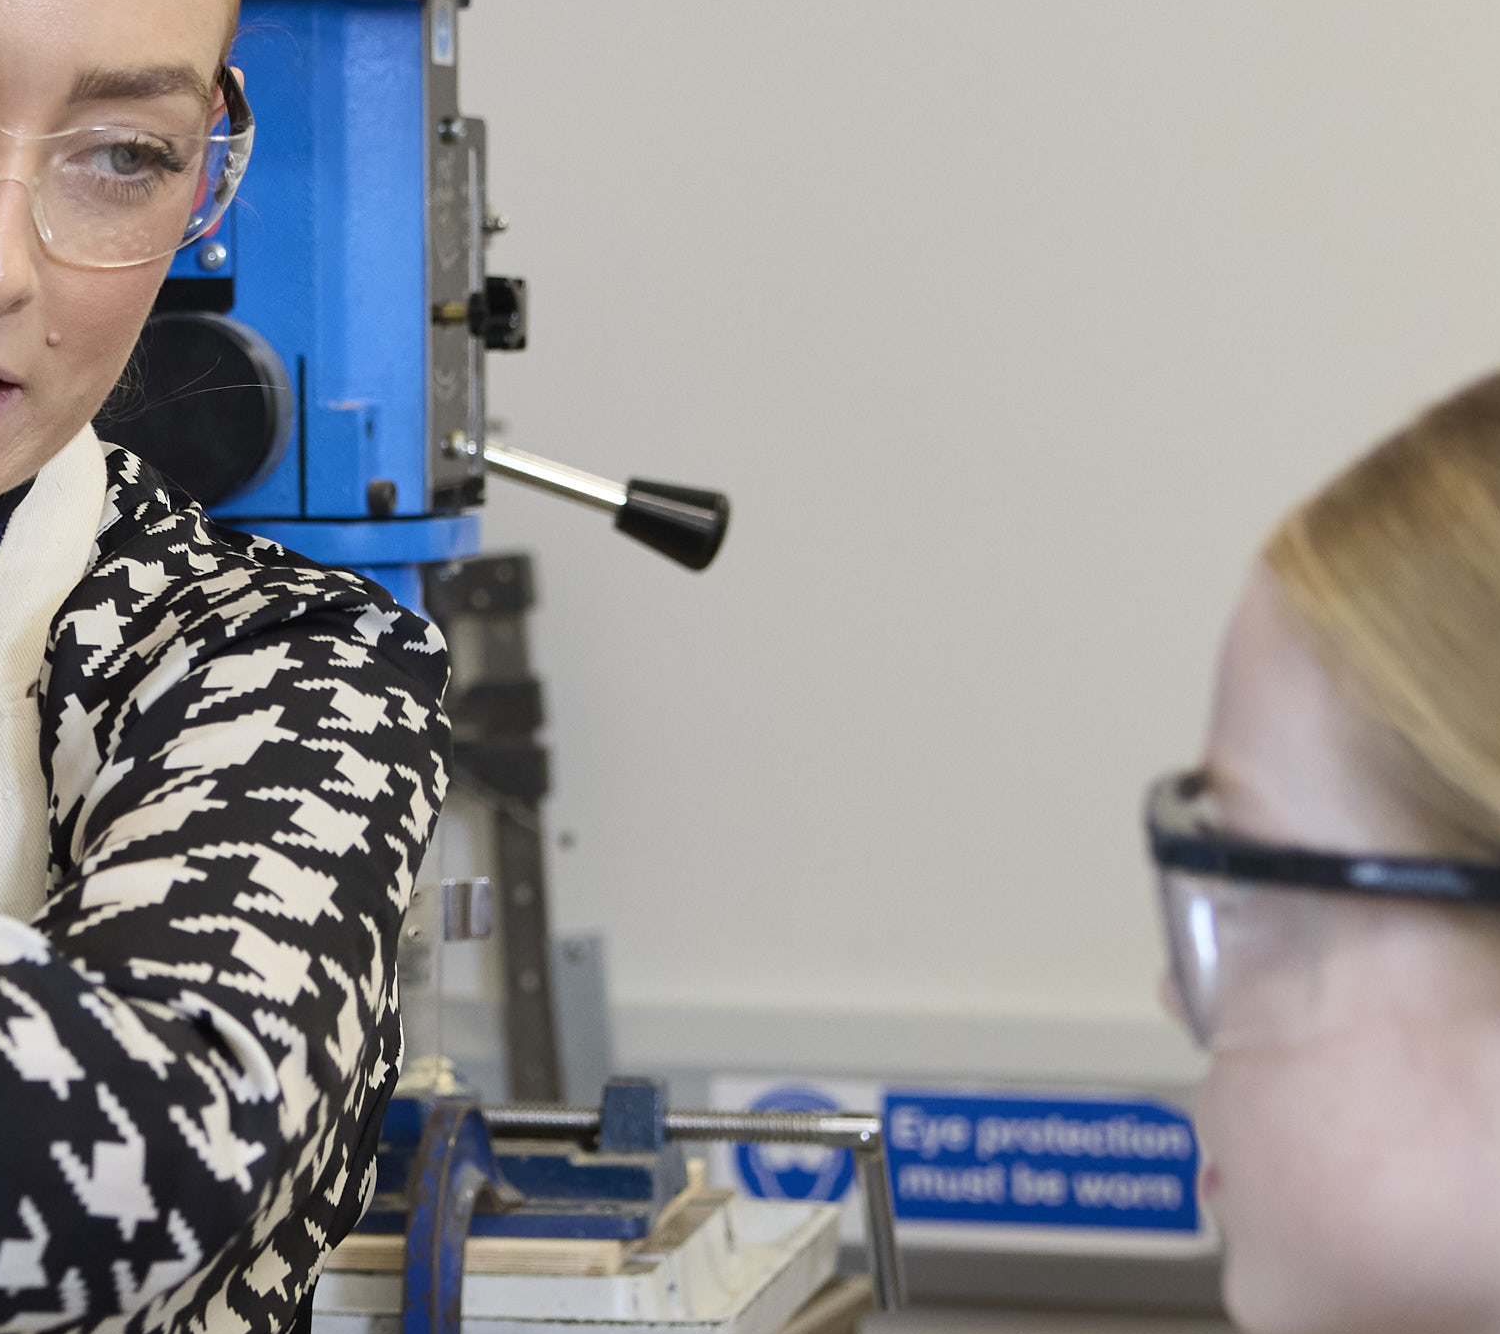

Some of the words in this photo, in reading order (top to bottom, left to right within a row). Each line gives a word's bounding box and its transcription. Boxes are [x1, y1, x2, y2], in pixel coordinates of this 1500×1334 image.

[891, 1106, 971, 1159] Eye
[976, 1113, 1192, 1161] protection
[899, 1164, 1006, 1205] must
[1011, 1163, 1068, 1206] be
[1073, 1171, 1183, 1210] worn
